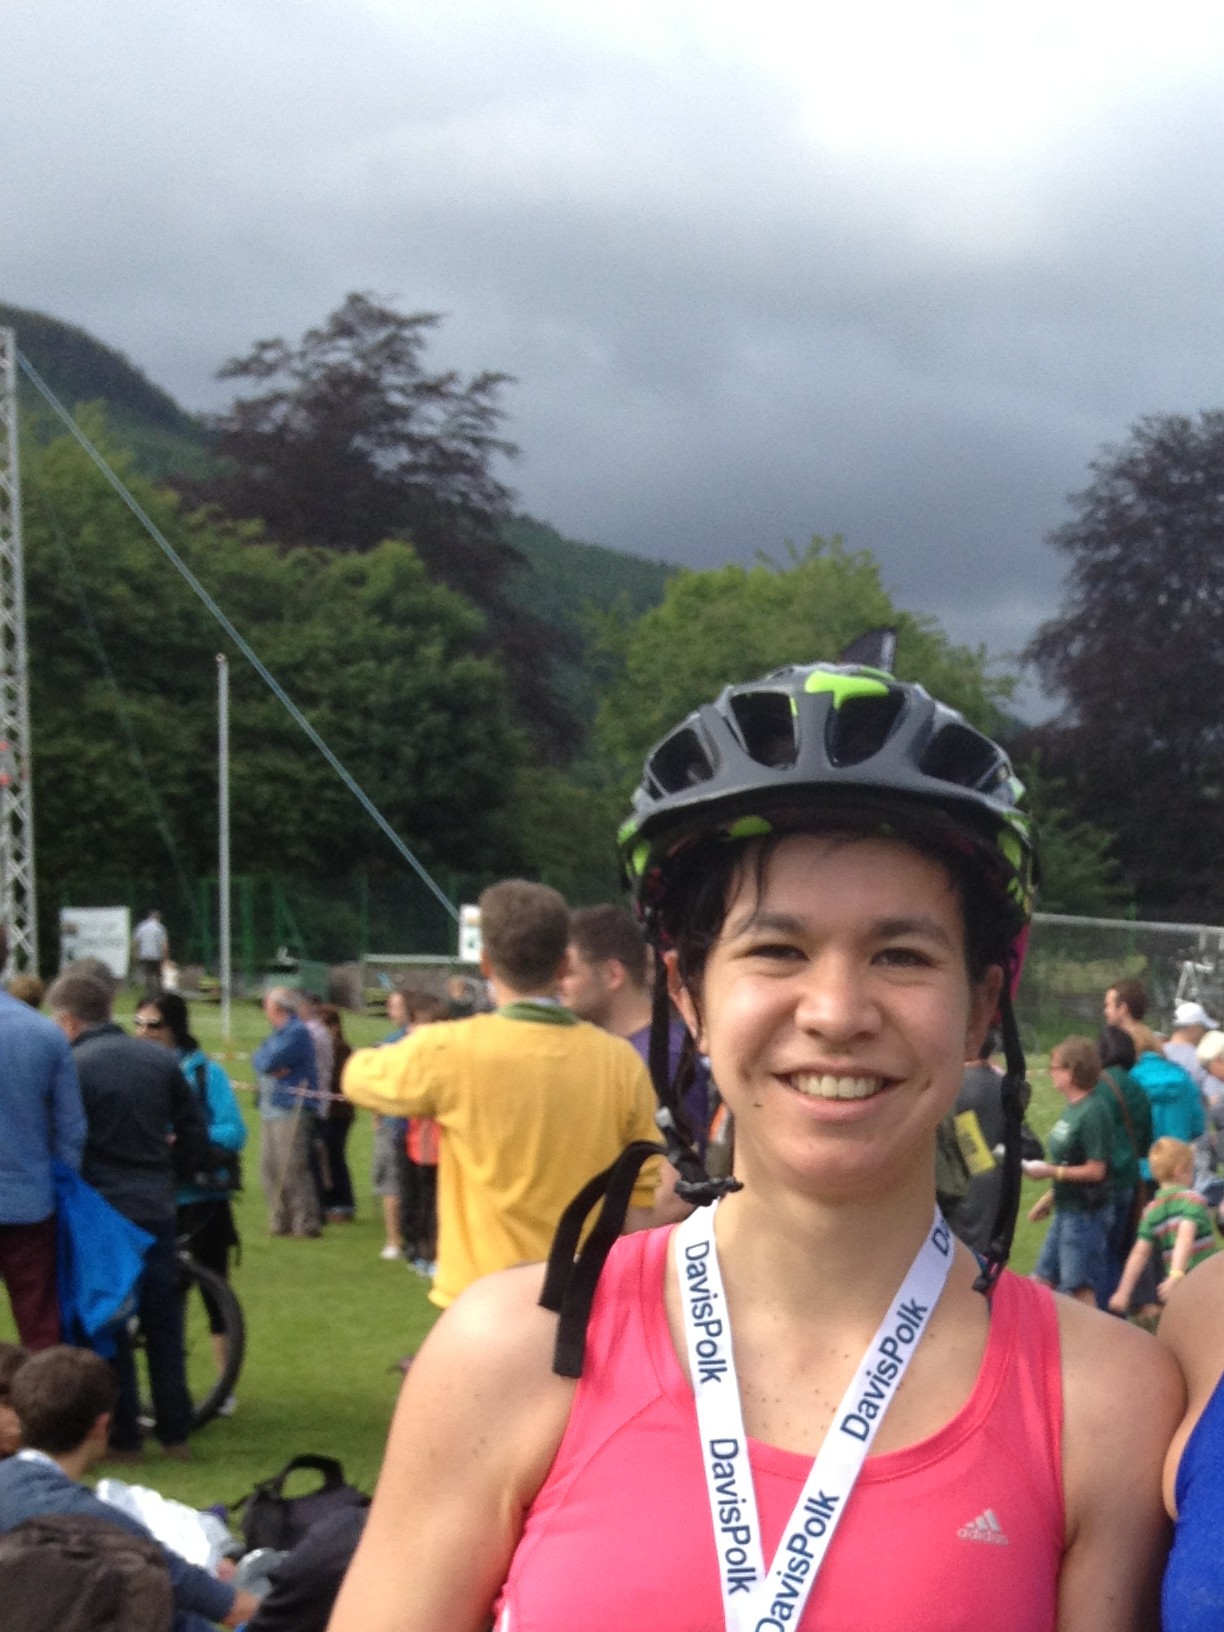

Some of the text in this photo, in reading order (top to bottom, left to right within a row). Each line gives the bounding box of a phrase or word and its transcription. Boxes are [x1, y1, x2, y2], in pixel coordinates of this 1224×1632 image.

[684, 1239, 727, 1385] DavisPolk
[840, 1298, 929, 1443] DavisPolk
[709, 1437, 759, 1595] DavisPolk
